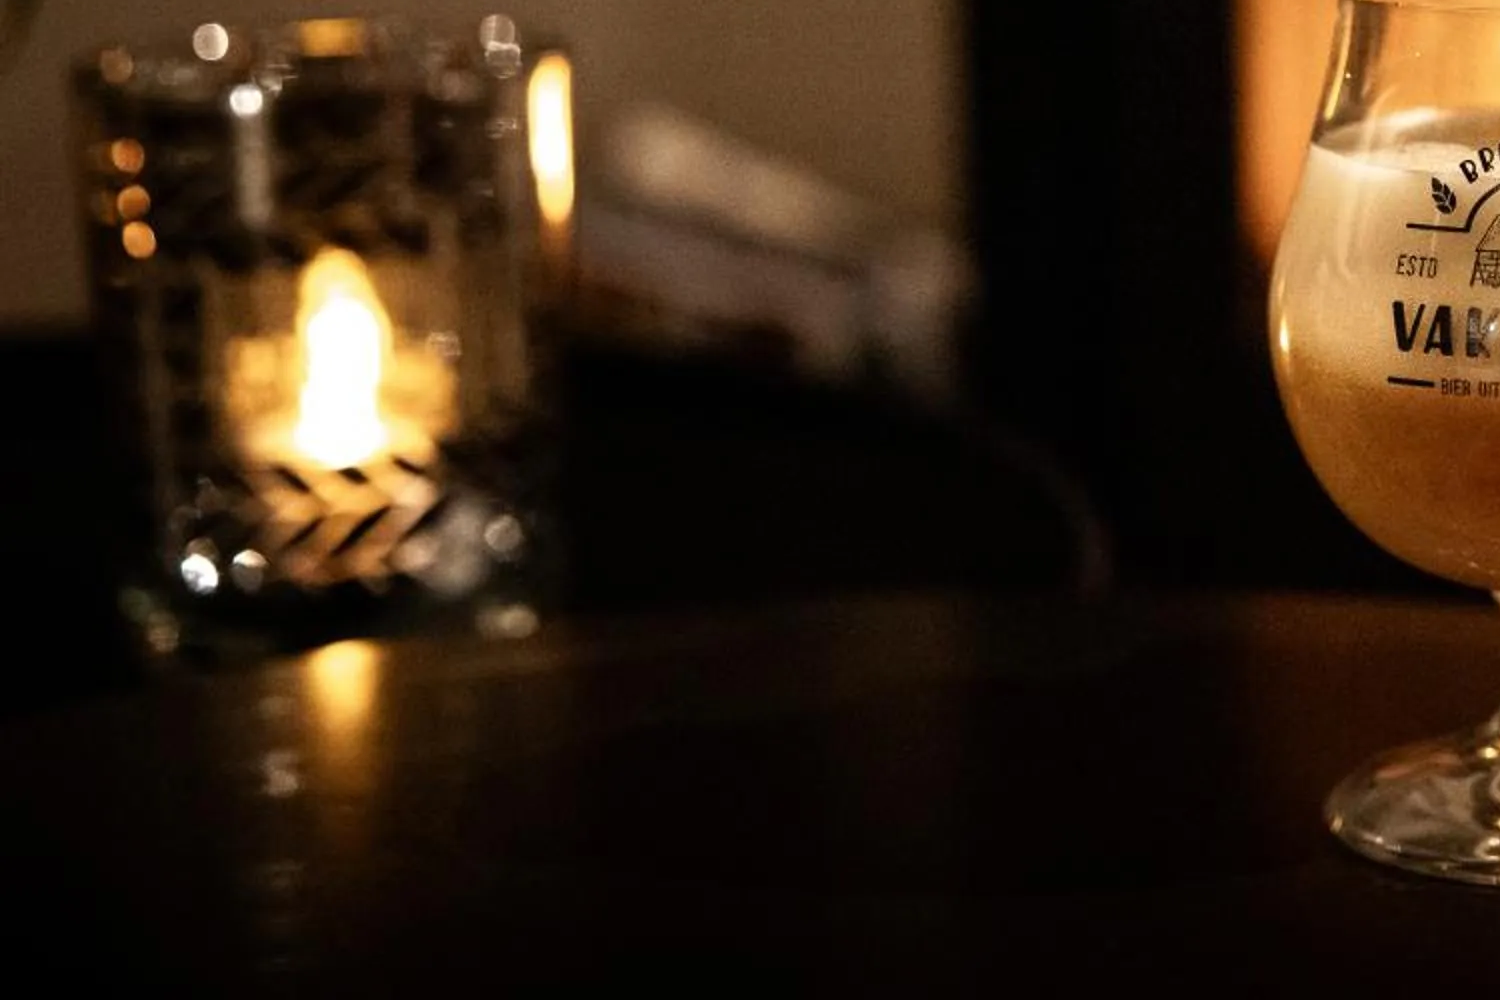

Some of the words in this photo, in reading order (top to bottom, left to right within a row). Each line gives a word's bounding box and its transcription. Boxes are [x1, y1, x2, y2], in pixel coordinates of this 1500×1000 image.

[1395, 253, 1440, 279] ESTD
[1440, 377, 1471, 396] BIER
[1478, 380, 1500, 398] UIT
